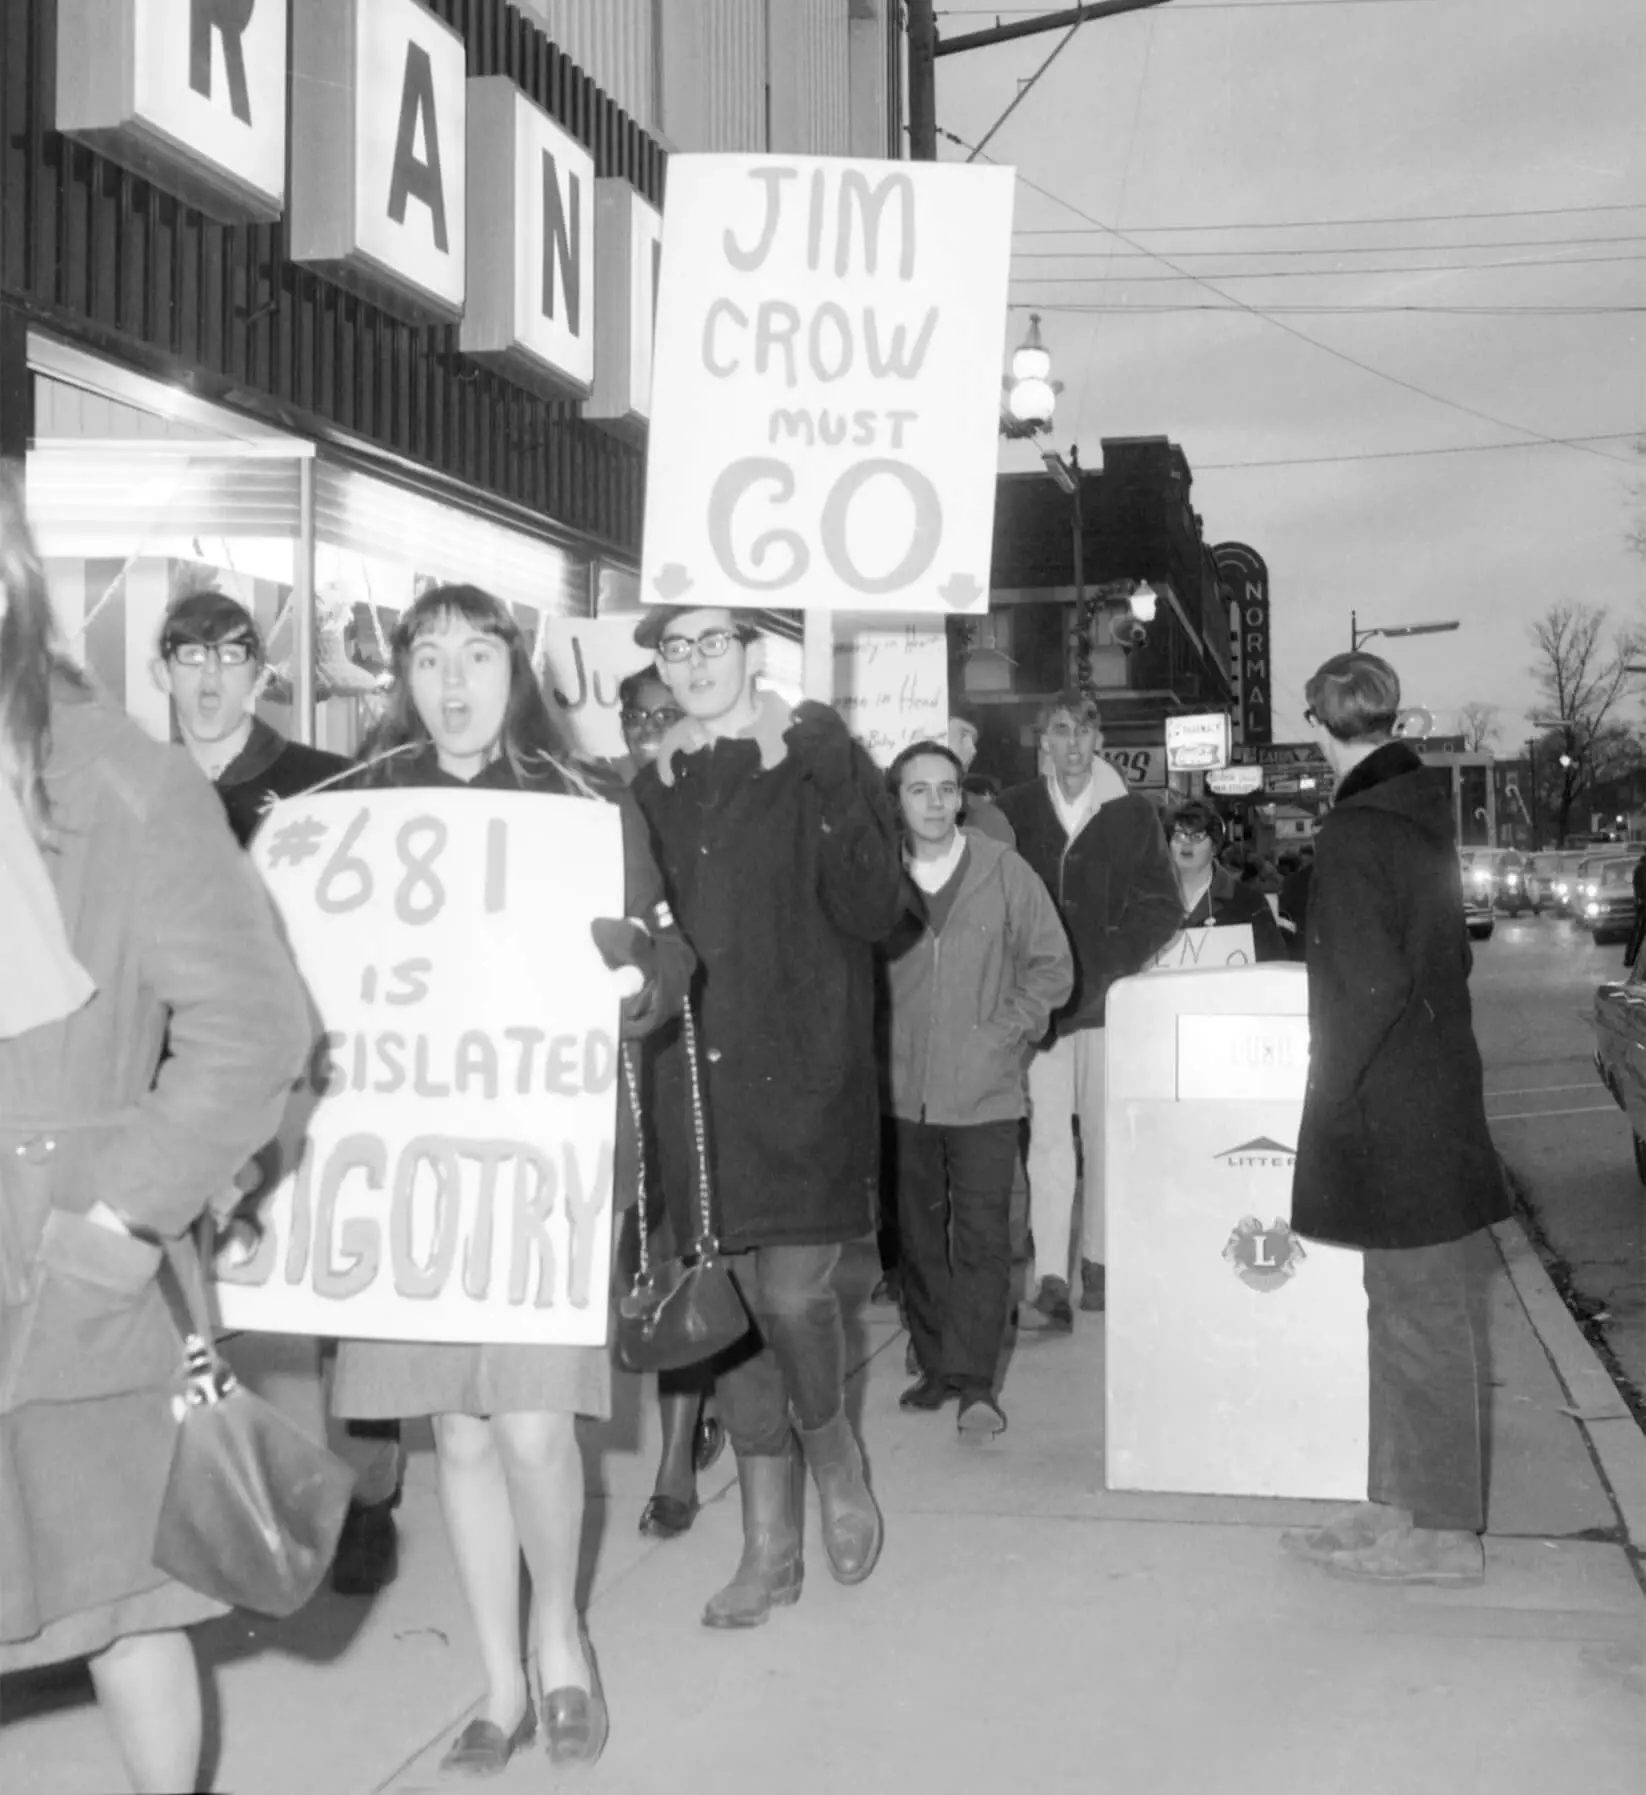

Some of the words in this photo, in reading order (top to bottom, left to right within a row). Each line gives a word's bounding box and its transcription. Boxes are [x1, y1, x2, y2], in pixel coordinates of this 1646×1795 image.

[722, 166, 916, 282] JIM
[702, 298, 940, 388] CROW
[768, 407, 919, 449] MUST
[707, 456, 944, 595] GO
[1244, 580, 1266, 732] NORMAL
[266, 807, 508, 926] #681
[359, 956, 433, 1005] IS
[292, 1026, 618, 1100] GISLATED
[1252, 1235, 1277, 1267] L
